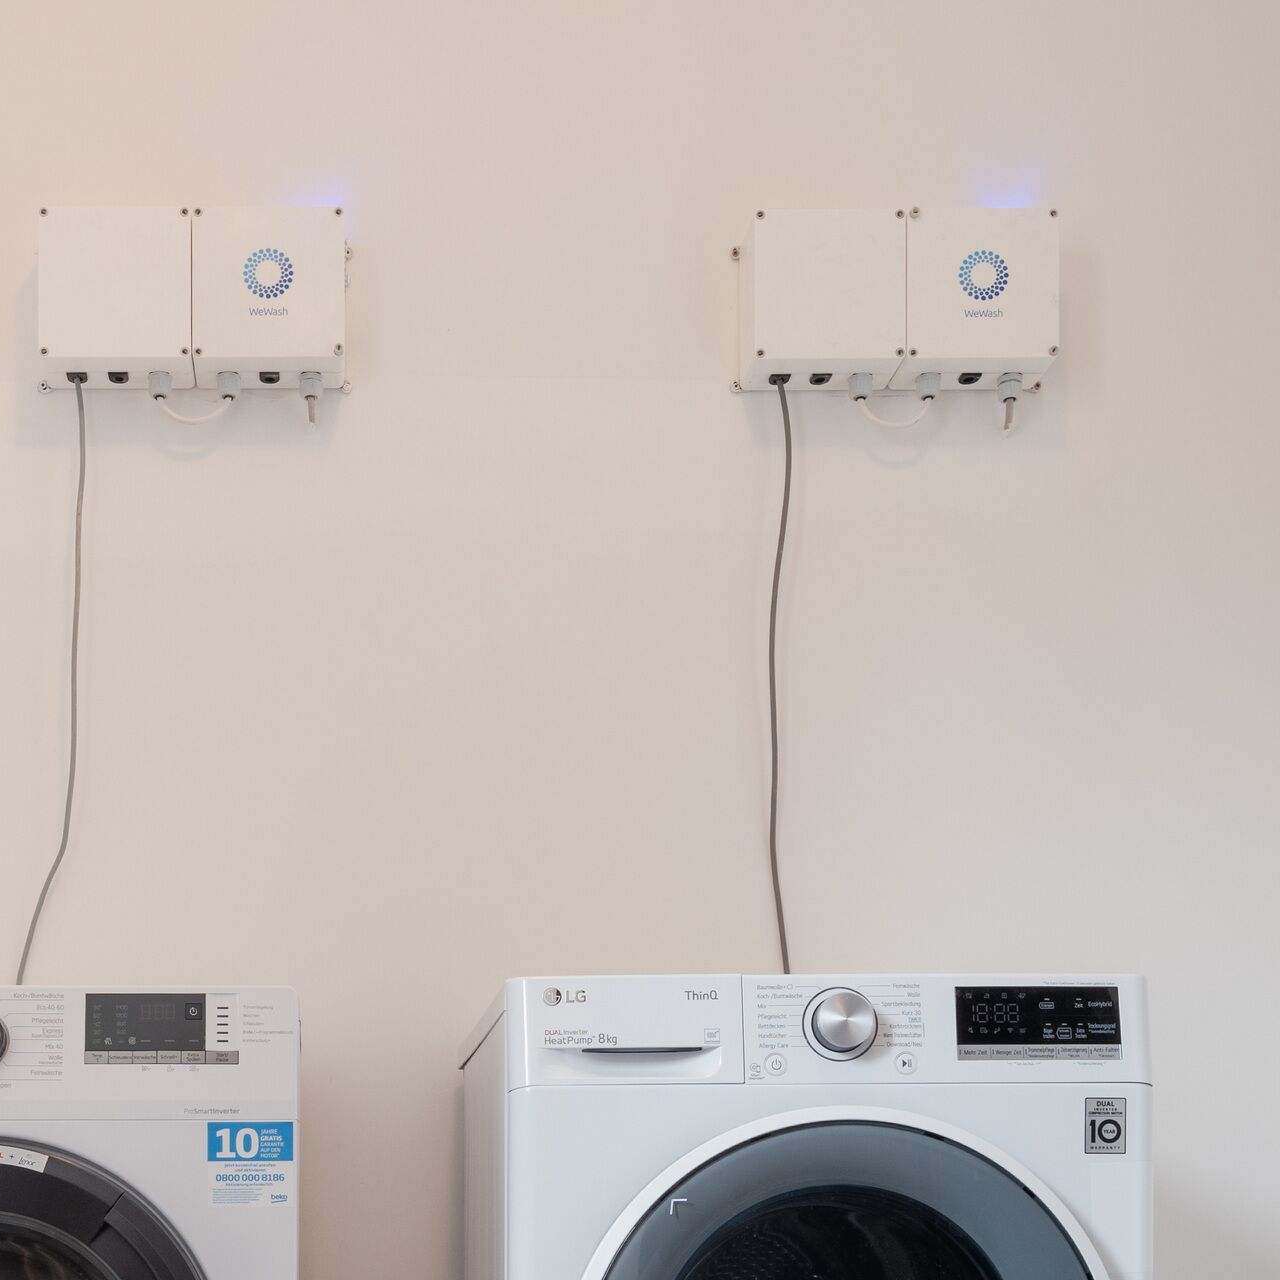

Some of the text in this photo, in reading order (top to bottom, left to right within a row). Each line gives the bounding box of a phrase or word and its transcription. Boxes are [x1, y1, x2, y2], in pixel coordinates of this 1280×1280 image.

[249, 307, 288, 316] WeWash
[964, 308, 1003, 317] WeWash
[565, 990, 587, 1003] LG
[685, 990, 719, 1001] ThinQ
[1090, 1118, 1122, 1143] 10
[216, 1128, 259, 1158] 10
[215, 1173, 285, 1182] 0800 000 8186
[270, 1194, 288, 1202] beko
